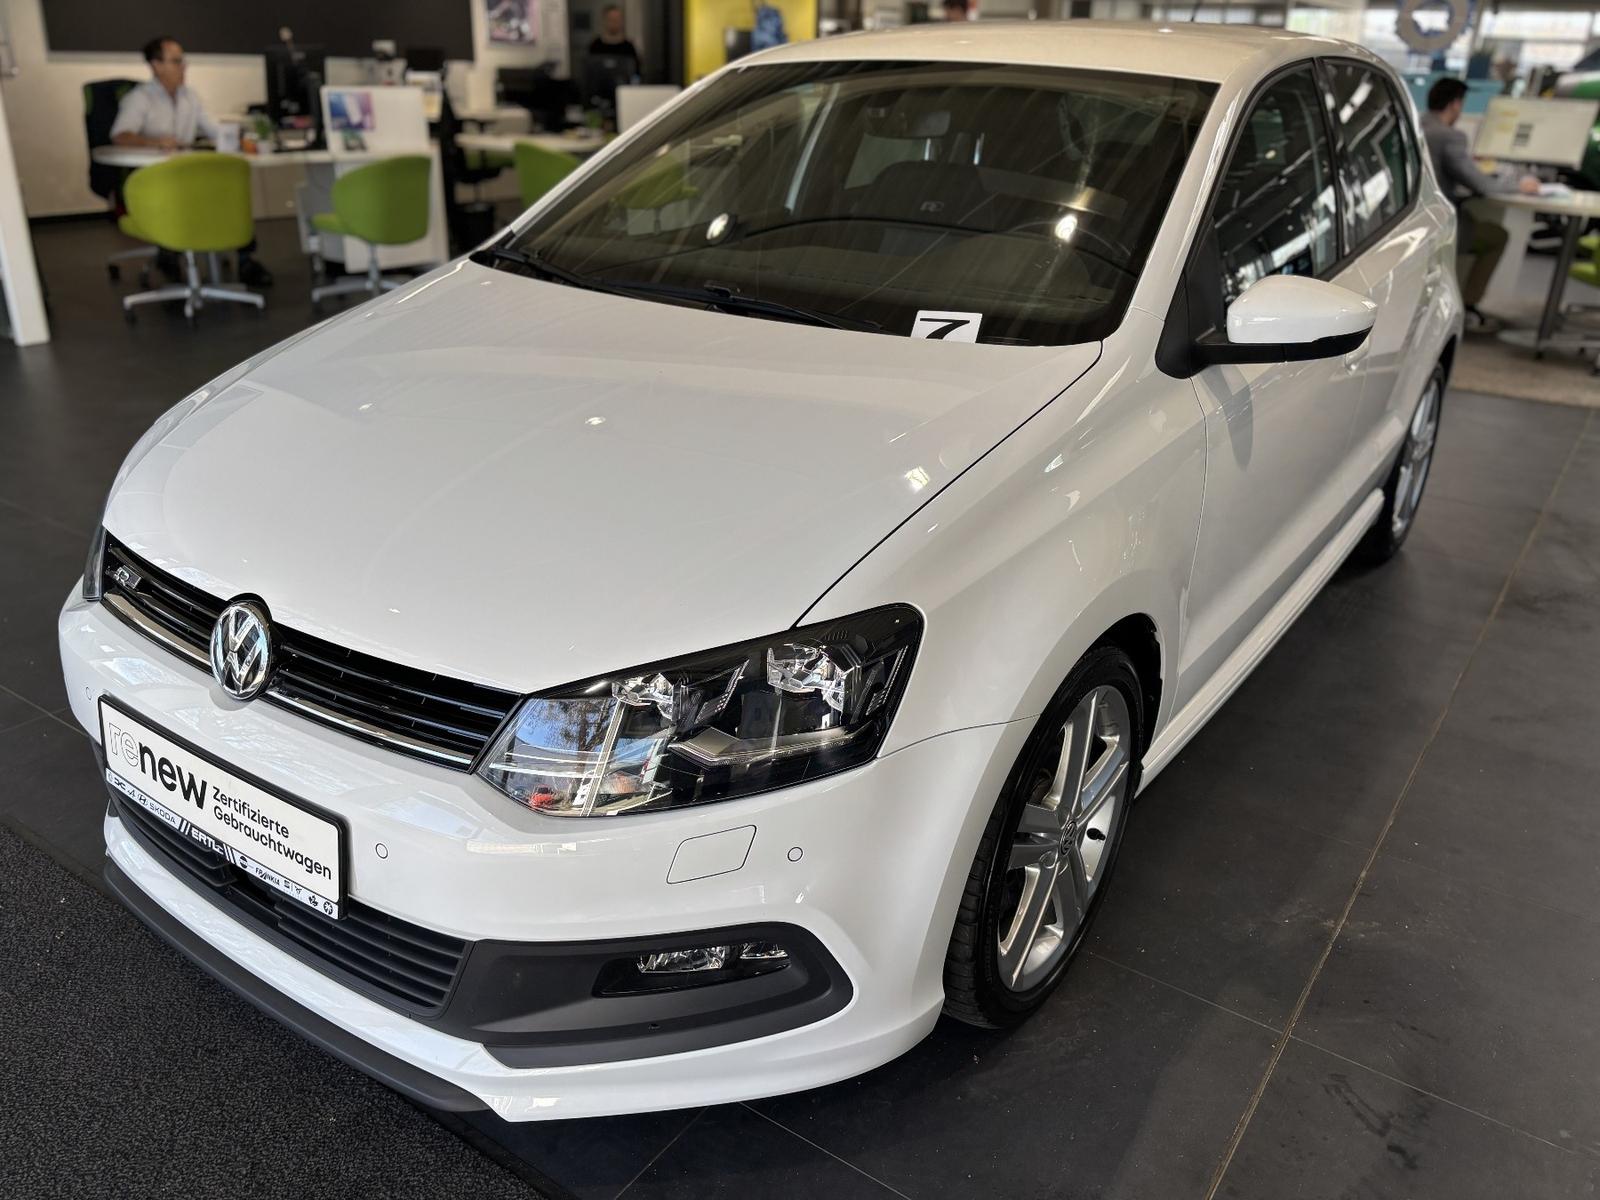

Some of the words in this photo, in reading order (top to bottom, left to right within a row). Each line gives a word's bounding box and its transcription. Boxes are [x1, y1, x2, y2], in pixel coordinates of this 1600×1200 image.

[108, 722, 208, 810] renew
[212, 785, 290, 839] Zertifizierte
[213, 805, 332, 881] Gebrauchtwagen
